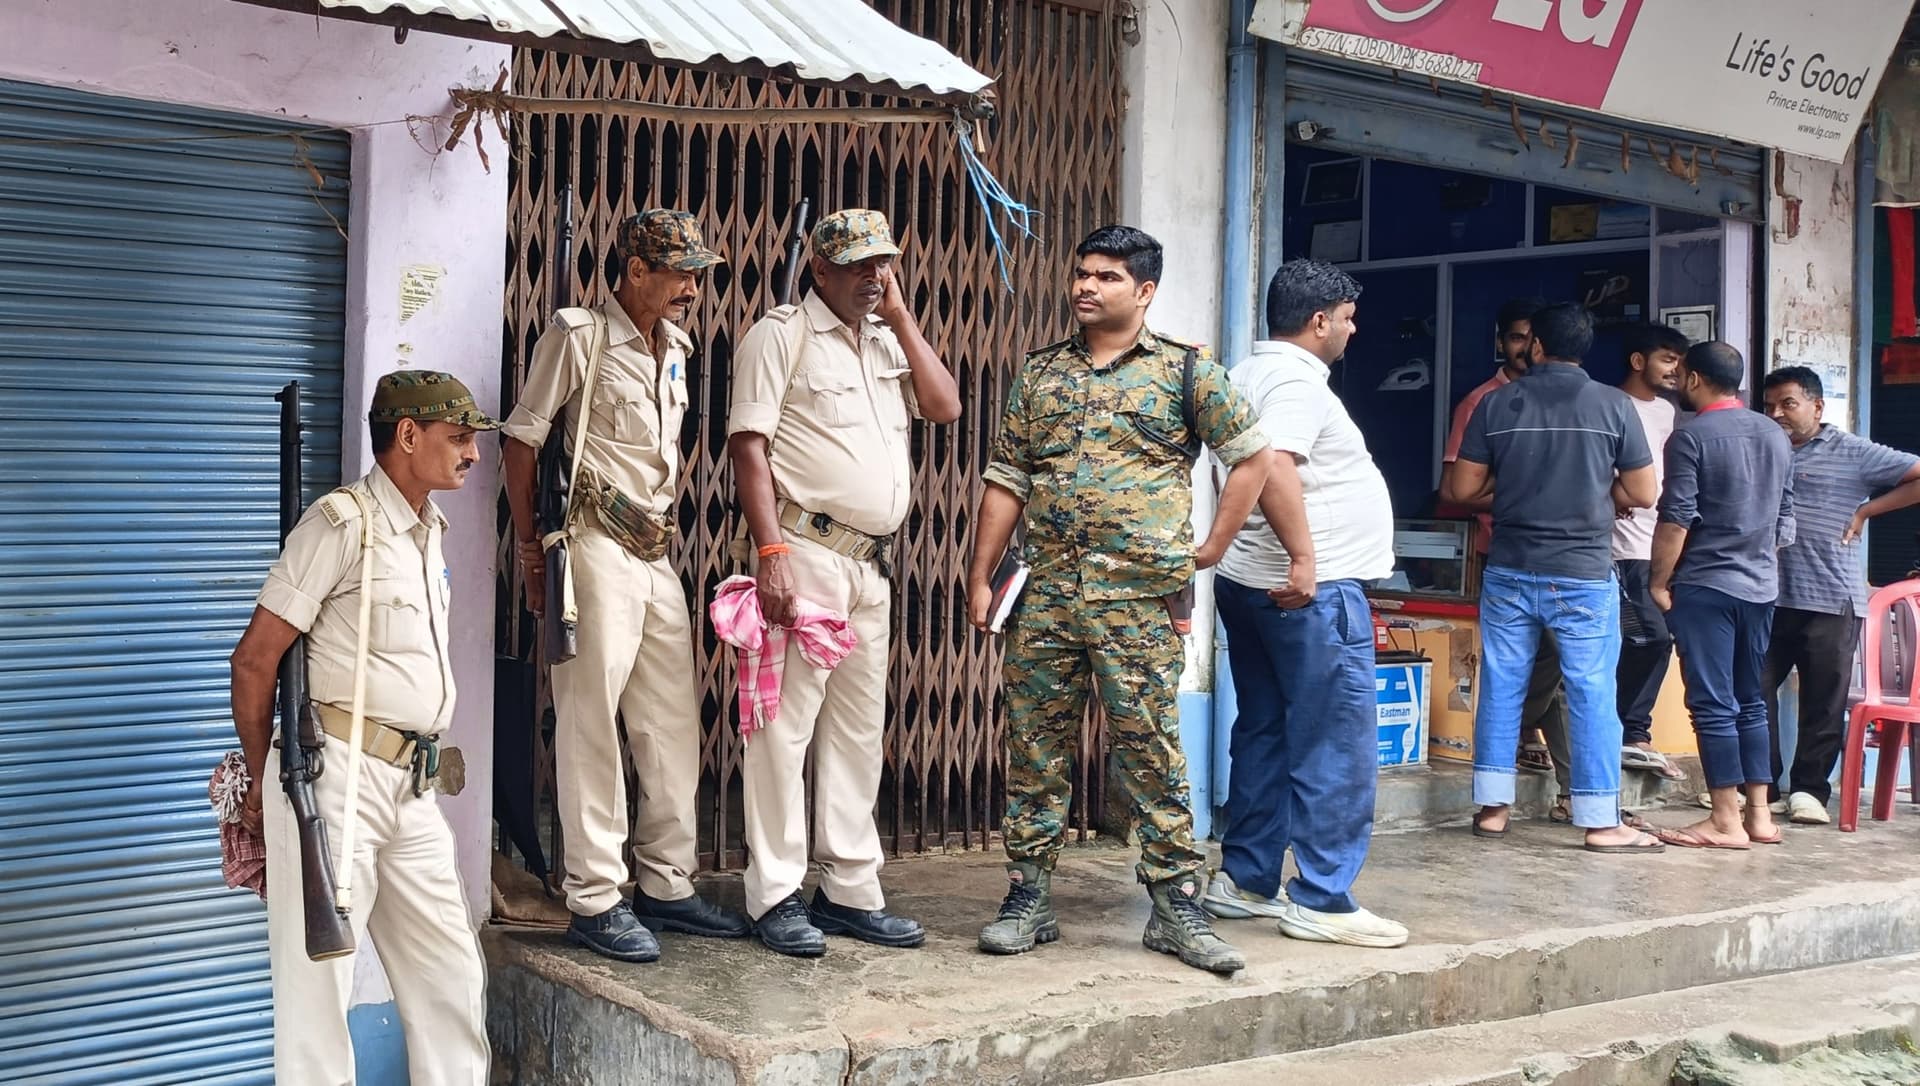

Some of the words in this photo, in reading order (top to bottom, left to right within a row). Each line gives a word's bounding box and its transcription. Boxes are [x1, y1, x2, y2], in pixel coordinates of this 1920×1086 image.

[1725, 31, 1796, 82] Life's
[1800, 52, 1870, 100] Good
[1766, 90, 1798, 111] Prince
[1798, 98, 1850, 124] Electronics
[1797, 123, 1841, 140] www.lg.com
[1380, 707, 1411, 719] Eastman
